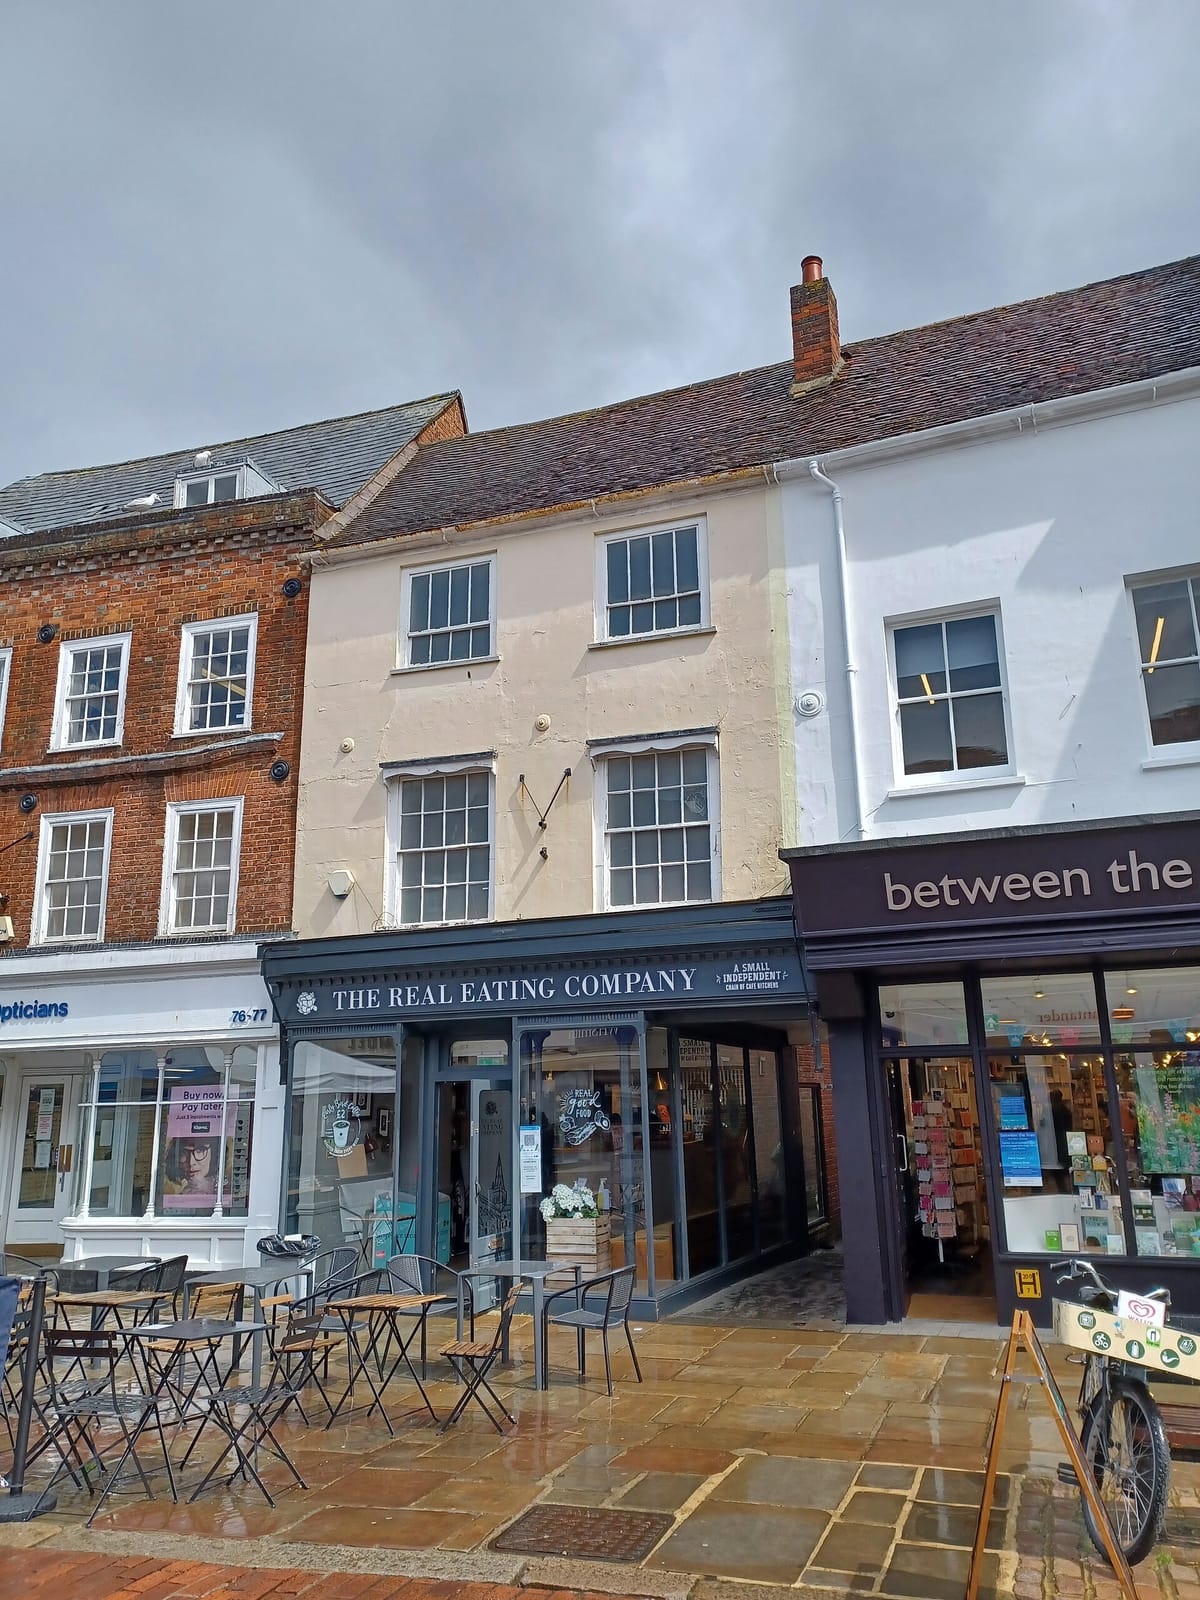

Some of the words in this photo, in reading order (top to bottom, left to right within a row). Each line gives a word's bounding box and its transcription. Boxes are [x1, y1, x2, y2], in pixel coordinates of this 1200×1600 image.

[883, 868, 1091, 911] between
[1106, 850, 1193, 894] the
[733, 963, 740, 973] A
[742, 962, 770, 972] SMALL
[723, 971, 782, 983] INDEPENDENT
[332, 988, 380, 1010] THE
[388, 984, 453, 1008] REAL
[460, 977, 556, 1003] EATING
[564, 969, 697, 998] COMPANY
[725, 983, 739, 991] CHAIN
[757, 981, 779, 989] KITCHENS
[0, 999, 69, 1023] pticians
[231, 1008, 268, 1023] 76-77
[183, 1091, 200, 1100] Buy
[574, 1089, 593, 1097] REAL
[181, 1103, 198, 1112] Pay
[567, 1091, 601, 1115] good
[336, 1109, 346, 1119] £2
[575, 1109, 592, 1118] FOOD
